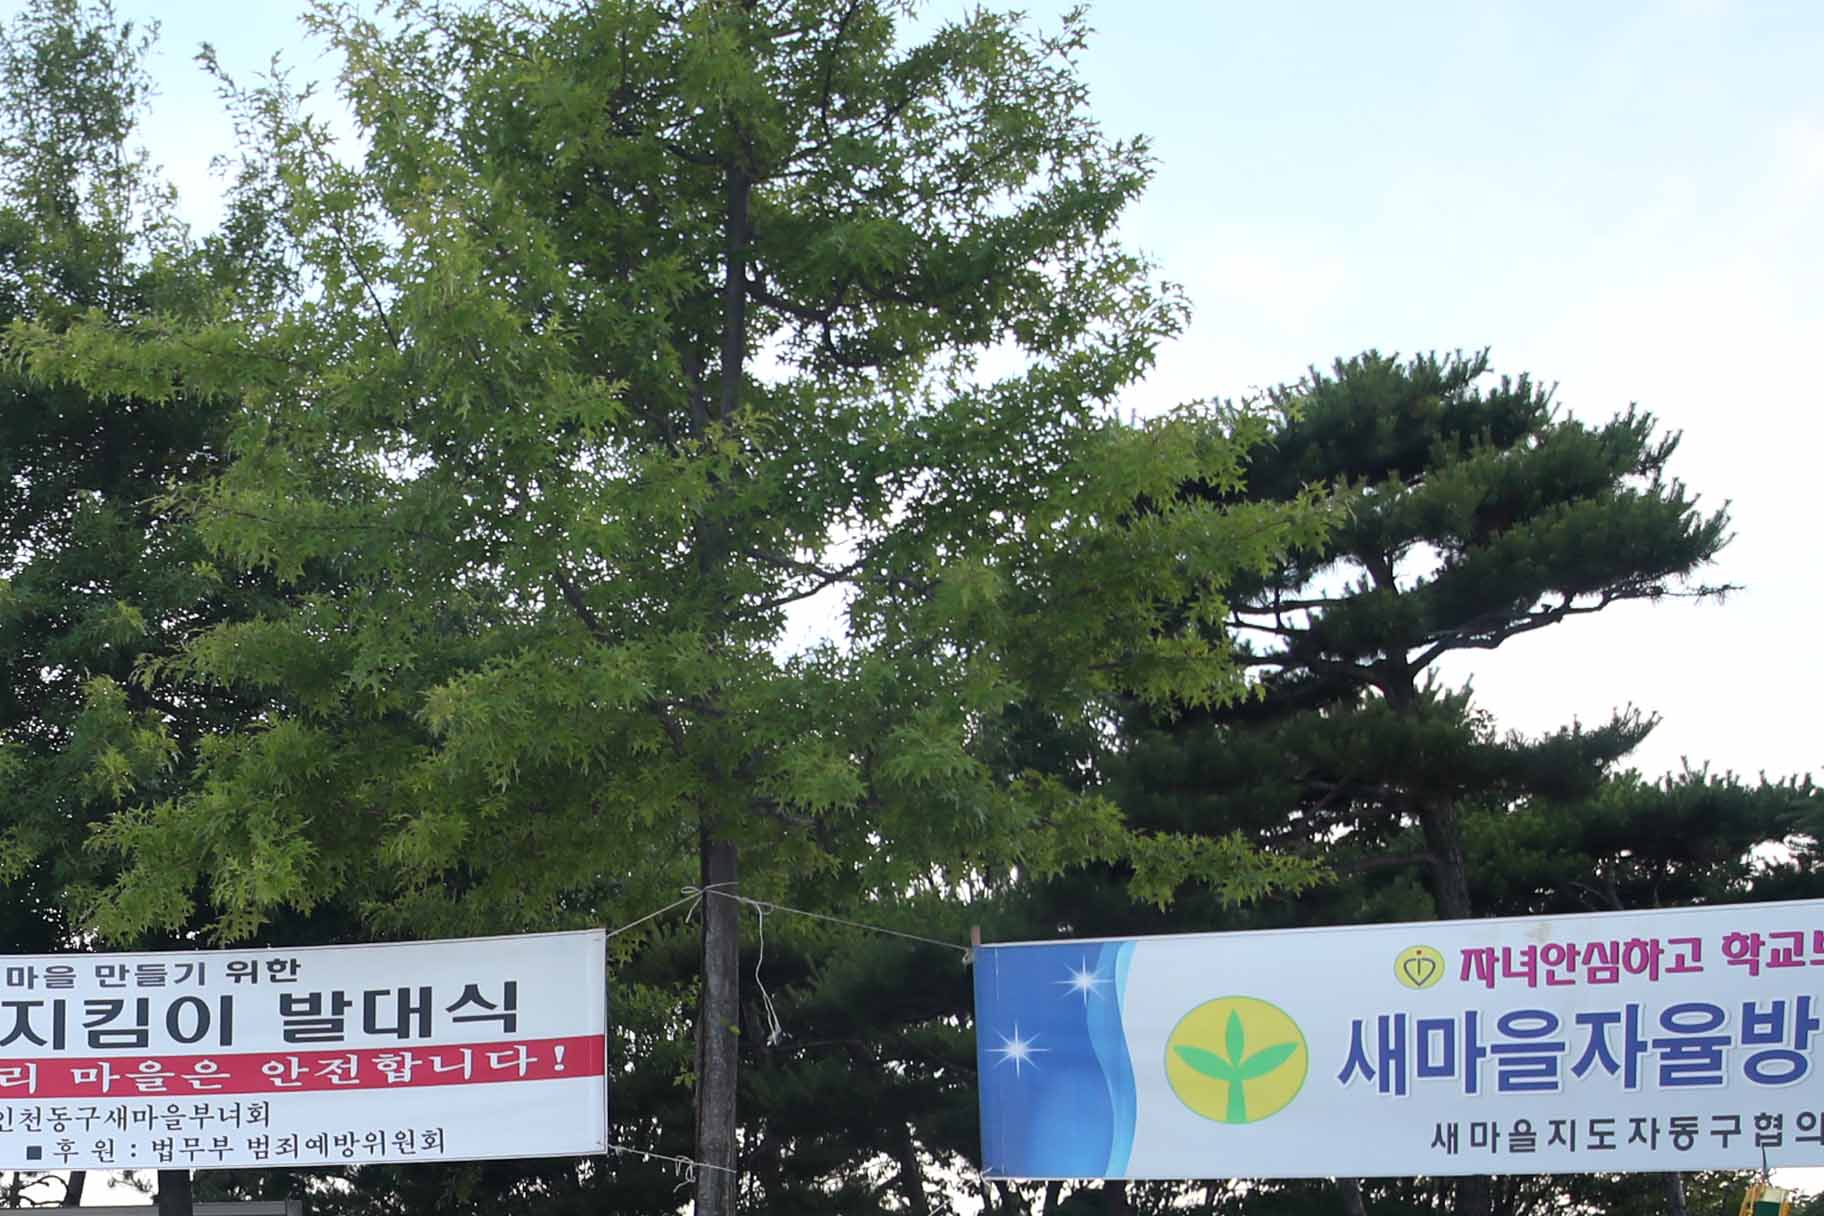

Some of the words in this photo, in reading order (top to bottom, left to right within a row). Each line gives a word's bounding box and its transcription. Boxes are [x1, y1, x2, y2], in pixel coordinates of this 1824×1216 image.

[7, 966, 76, 989] 마을
[96, 962, 205, 987] 만들기
[226, 959, 301, 984] 위한
[1460, 938, 1704, 988] 자녀안심하고
[279, 980, 518, 1043] 발대식
[71, 1060, 230, 1092] 마을은
[261, 1045, 567, 1088] 안전합니다!
[1339, 996, 1819, 1095] 새마을자율방
[152, 1137, 234, 1162] 법무부
[247, 1128, 446, 1162] 범죄예방위원회
